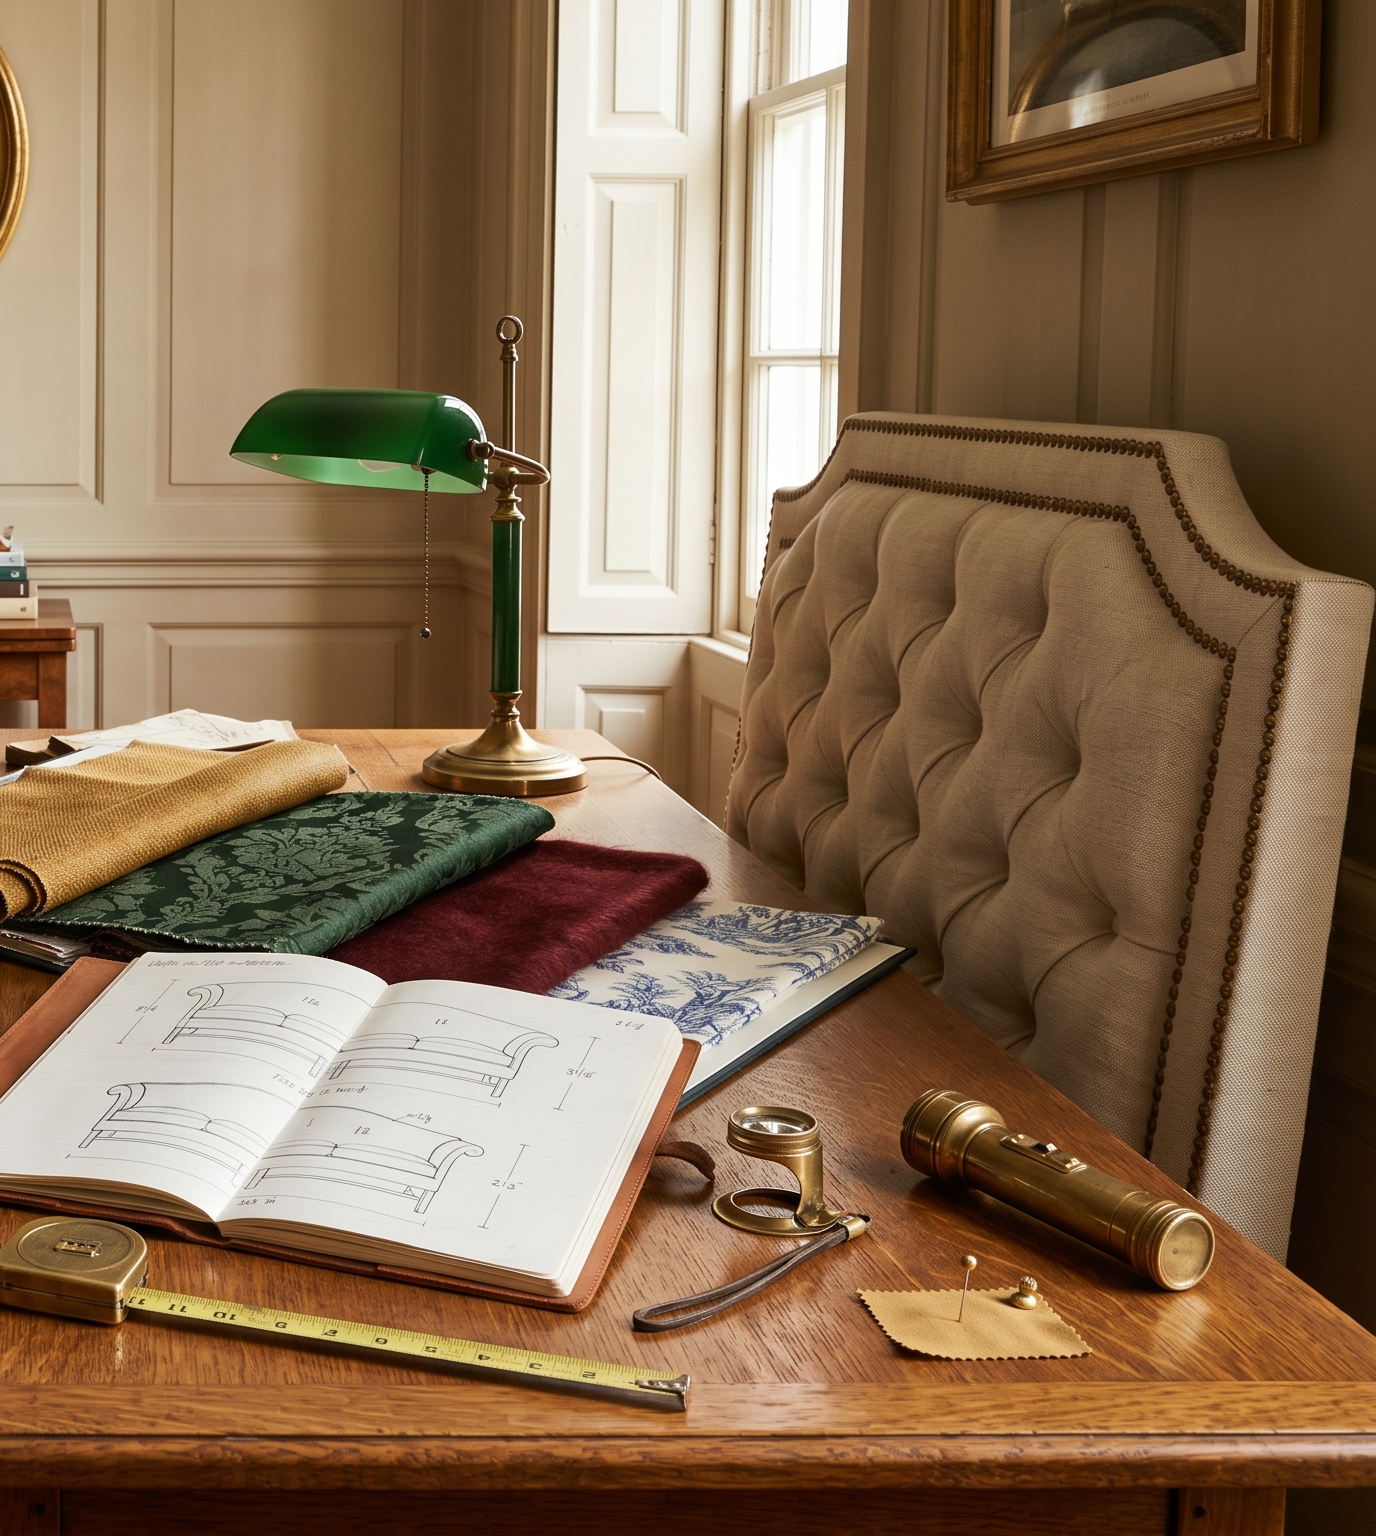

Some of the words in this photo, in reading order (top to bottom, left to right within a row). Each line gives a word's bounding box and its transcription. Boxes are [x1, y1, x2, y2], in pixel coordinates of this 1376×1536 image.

[213, 1310, 237, 1322] 10
[424, 1345, 438, 1354] 5
[477, 1353, 491, 1361] 4
[529, 1362, 543, 1371] 3
[581, 1370, 596, 1380] 2
